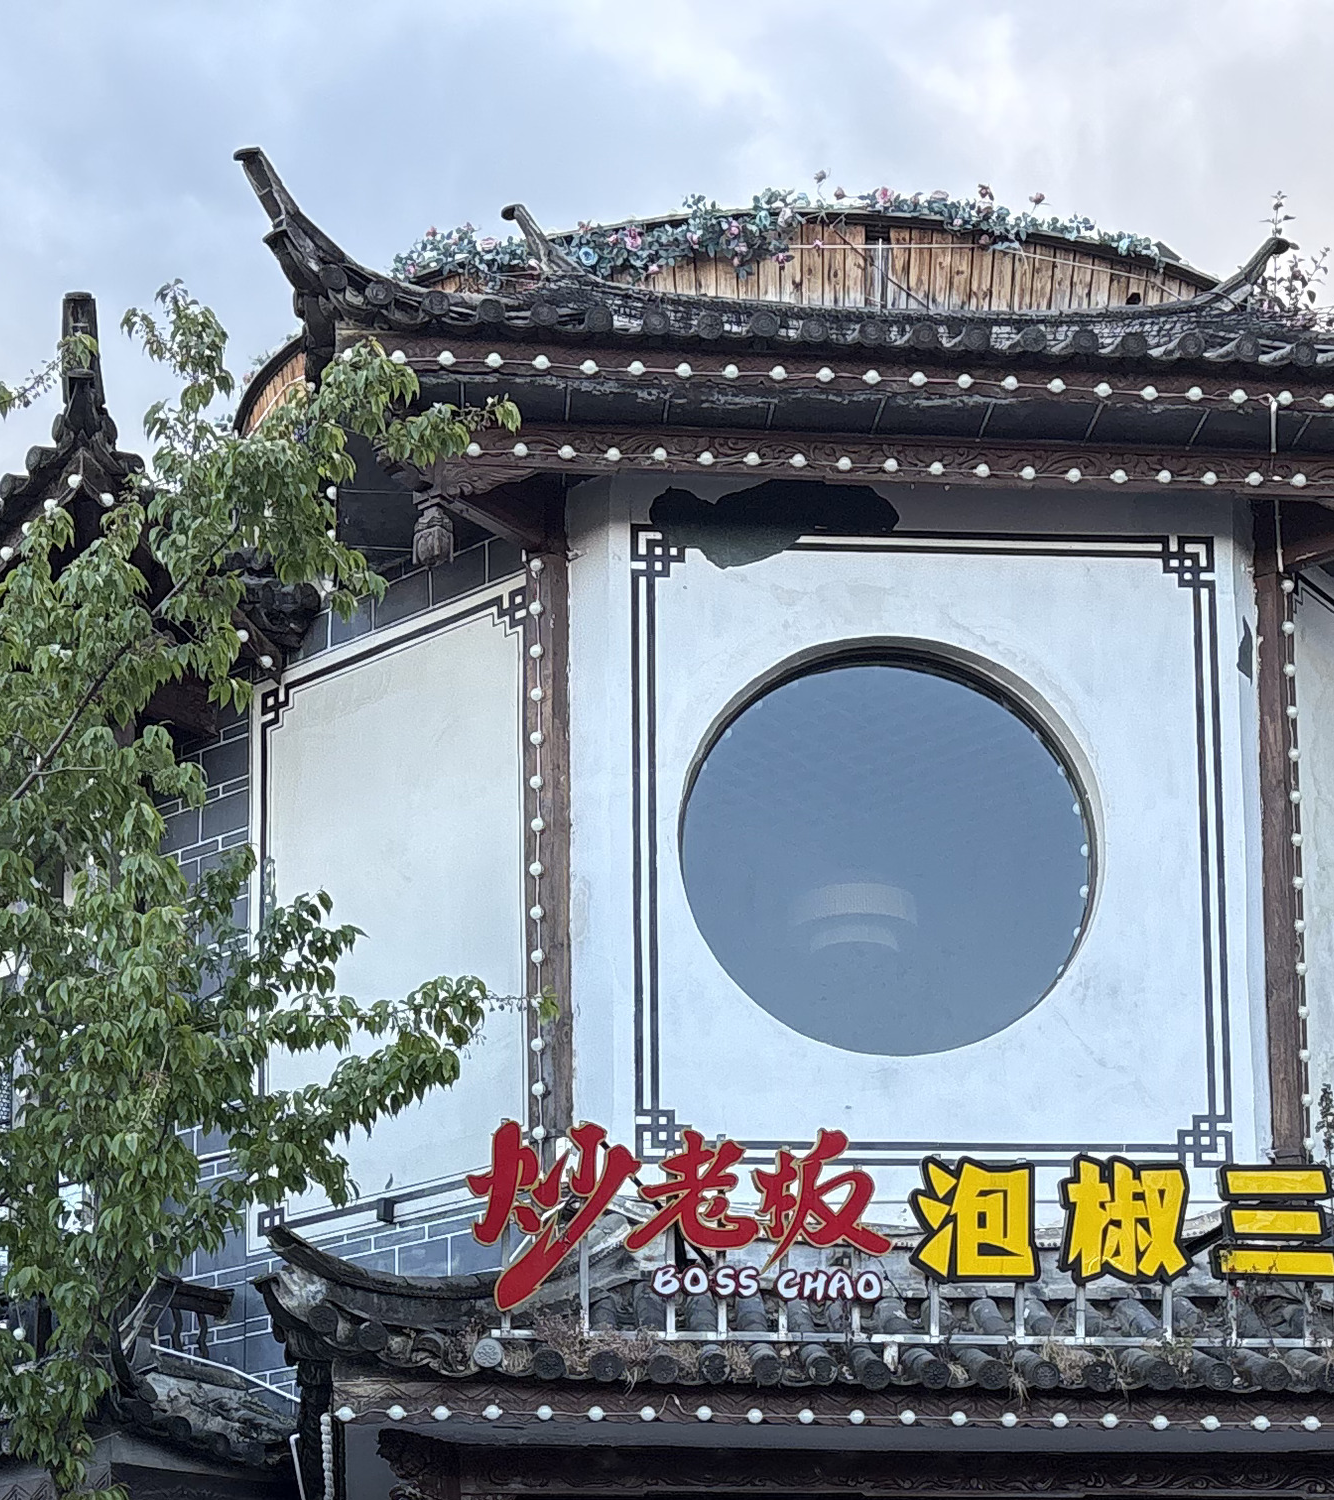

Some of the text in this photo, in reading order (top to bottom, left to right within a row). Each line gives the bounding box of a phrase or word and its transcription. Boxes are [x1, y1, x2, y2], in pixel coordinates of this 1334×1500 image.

[467, 1120, 893, 1312] 炒老板
[652, 1266, 882, 1300] BOSS CHAO
